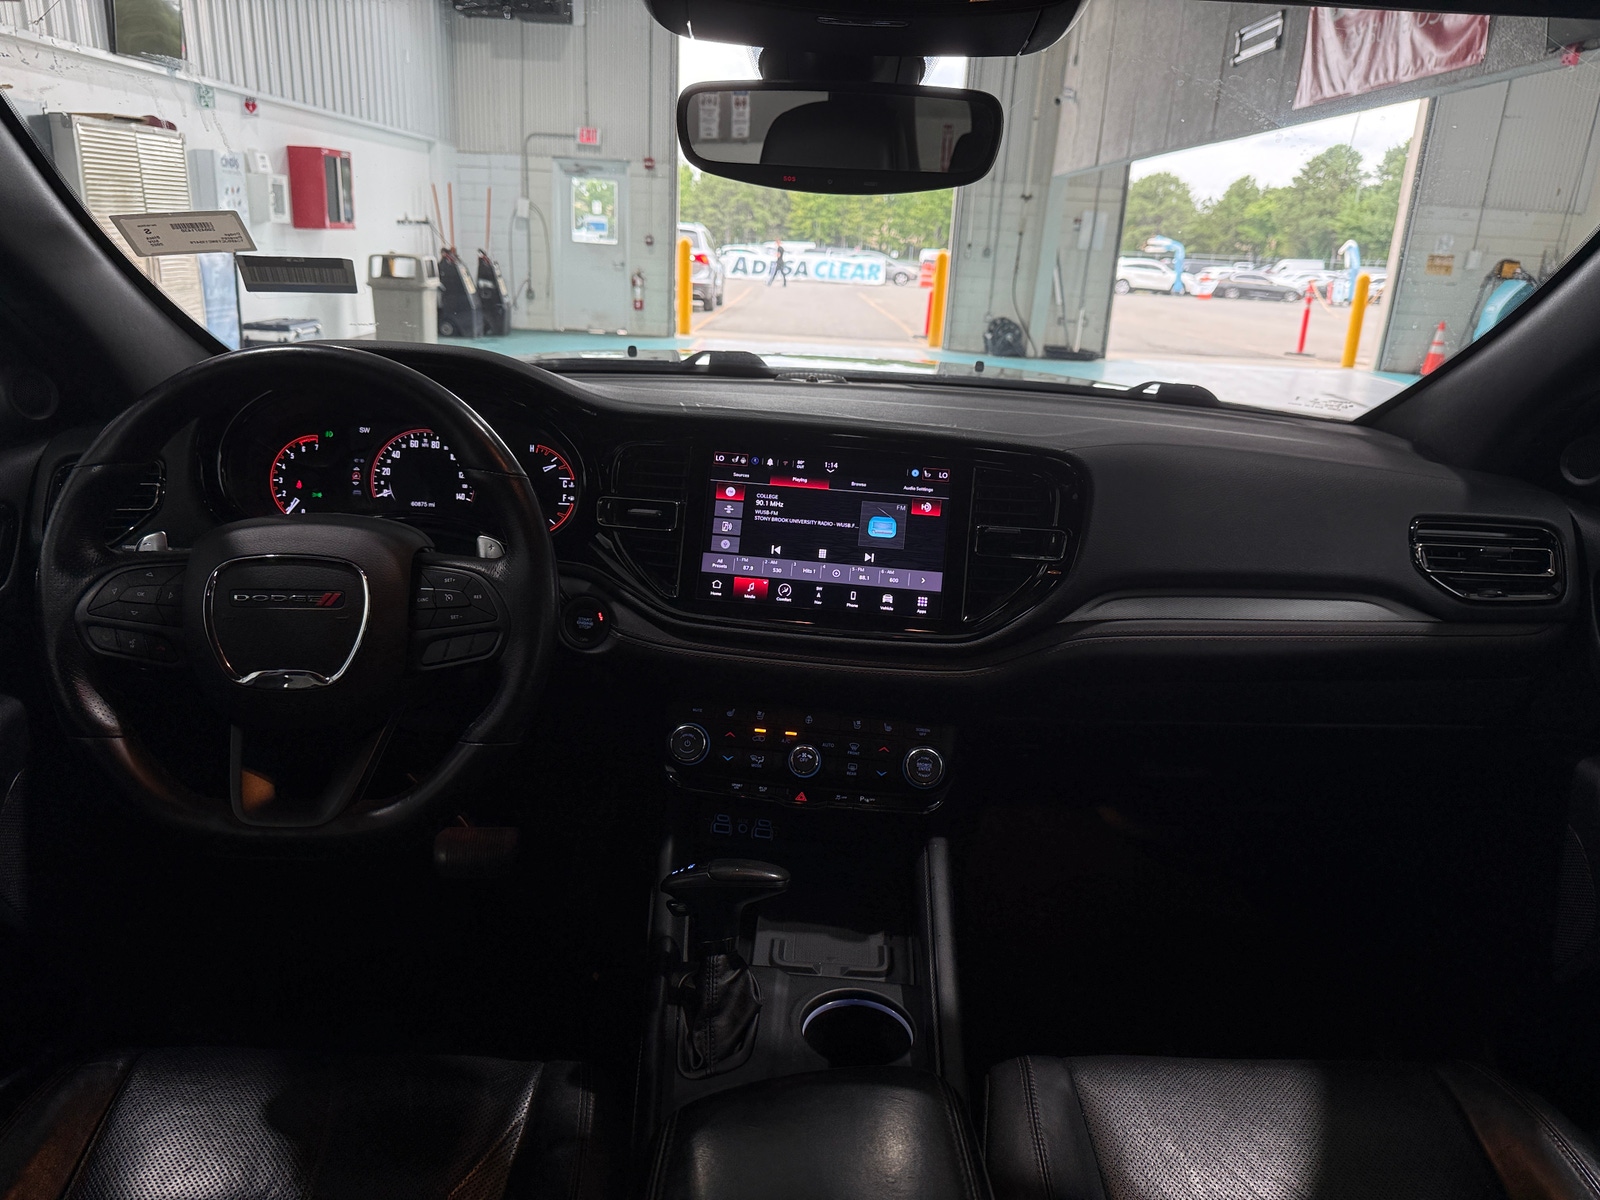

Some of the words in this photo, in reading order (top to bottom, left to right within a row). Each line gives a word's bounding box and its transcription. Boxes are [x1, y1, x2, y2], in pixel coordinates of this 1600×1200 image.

[579, 127, 597, 144] EXIT
[732, 257, 808, 276] ADSA
[815, 260, 881, 281] CLEAR
[410, 440, 419, 448] 60
[431, 441, 440, 449] 80
[530, 444, 535, 453] H
[392, 450, 401, 459] 40
[382, 468, 391, 476] 20
[563, 480, 568, 488] C
[562, 494, 567, 502] F
[789, 518, 817, 526] UNIVERSITY
[234, 594, 322, 603] DODGE
